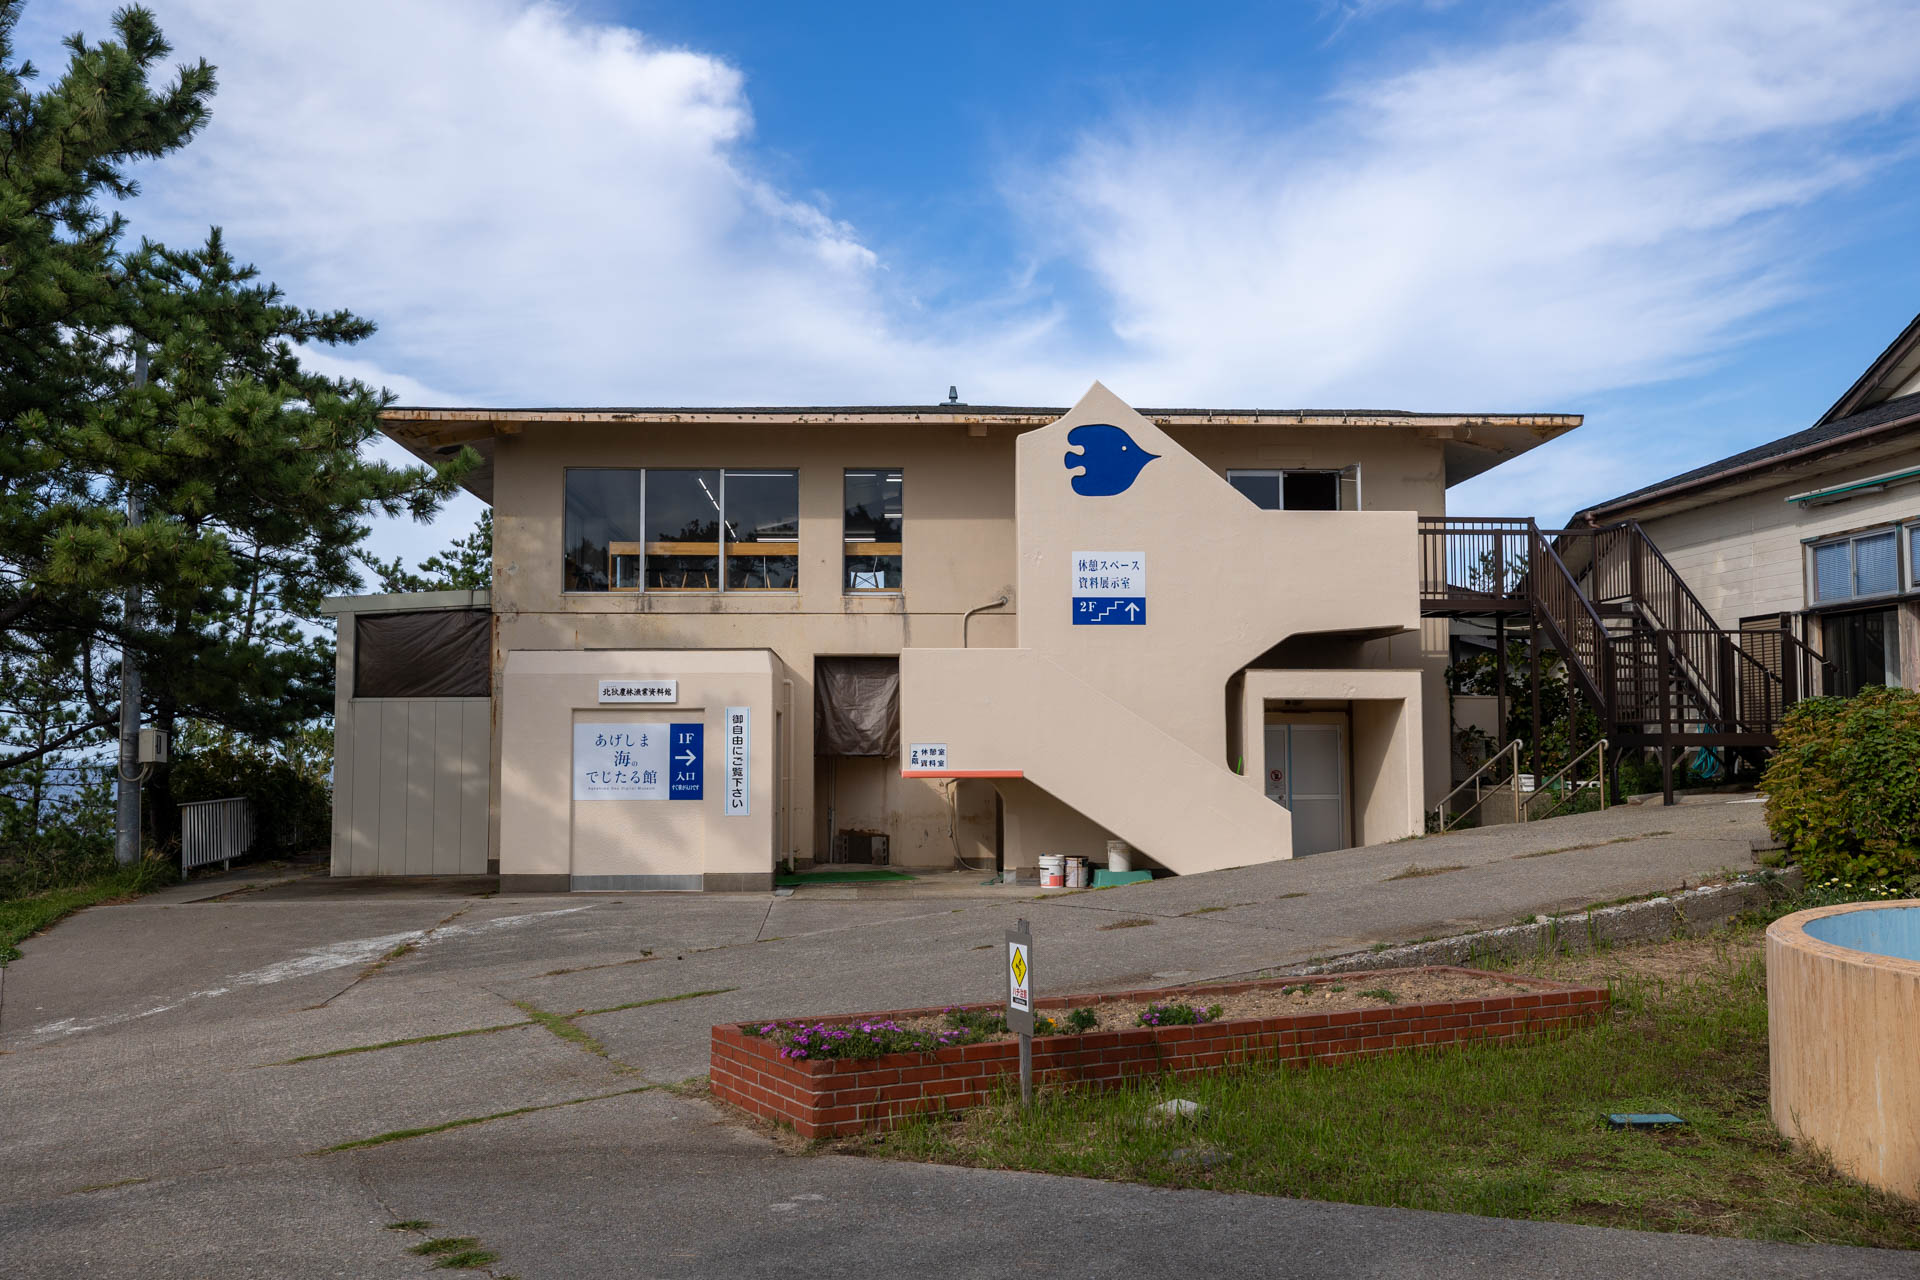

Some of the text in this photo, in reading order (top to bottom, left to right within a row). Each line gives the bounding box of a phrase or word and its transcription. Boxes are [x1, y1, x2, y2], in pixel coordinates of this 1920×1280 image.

[1078, 559, 1140, 572] 休憩スペース
[1078, 576, 1131, 589] 資料展示室
[1079, 601, 1097, 612] 2F
[595, 733, 649, 748] あげしま
[678, 732, 695, 744] 1F
[614, 750, 638, 767] 海の
[921, 748, 946, 756] 休憩室
[732, 714, 744, 809] 御自由にご覧下さい
[920, 759, 945, 767] 資料室
[586, 769, 658, 785] でじたる館
[676, 771, 695, 781] 入口
